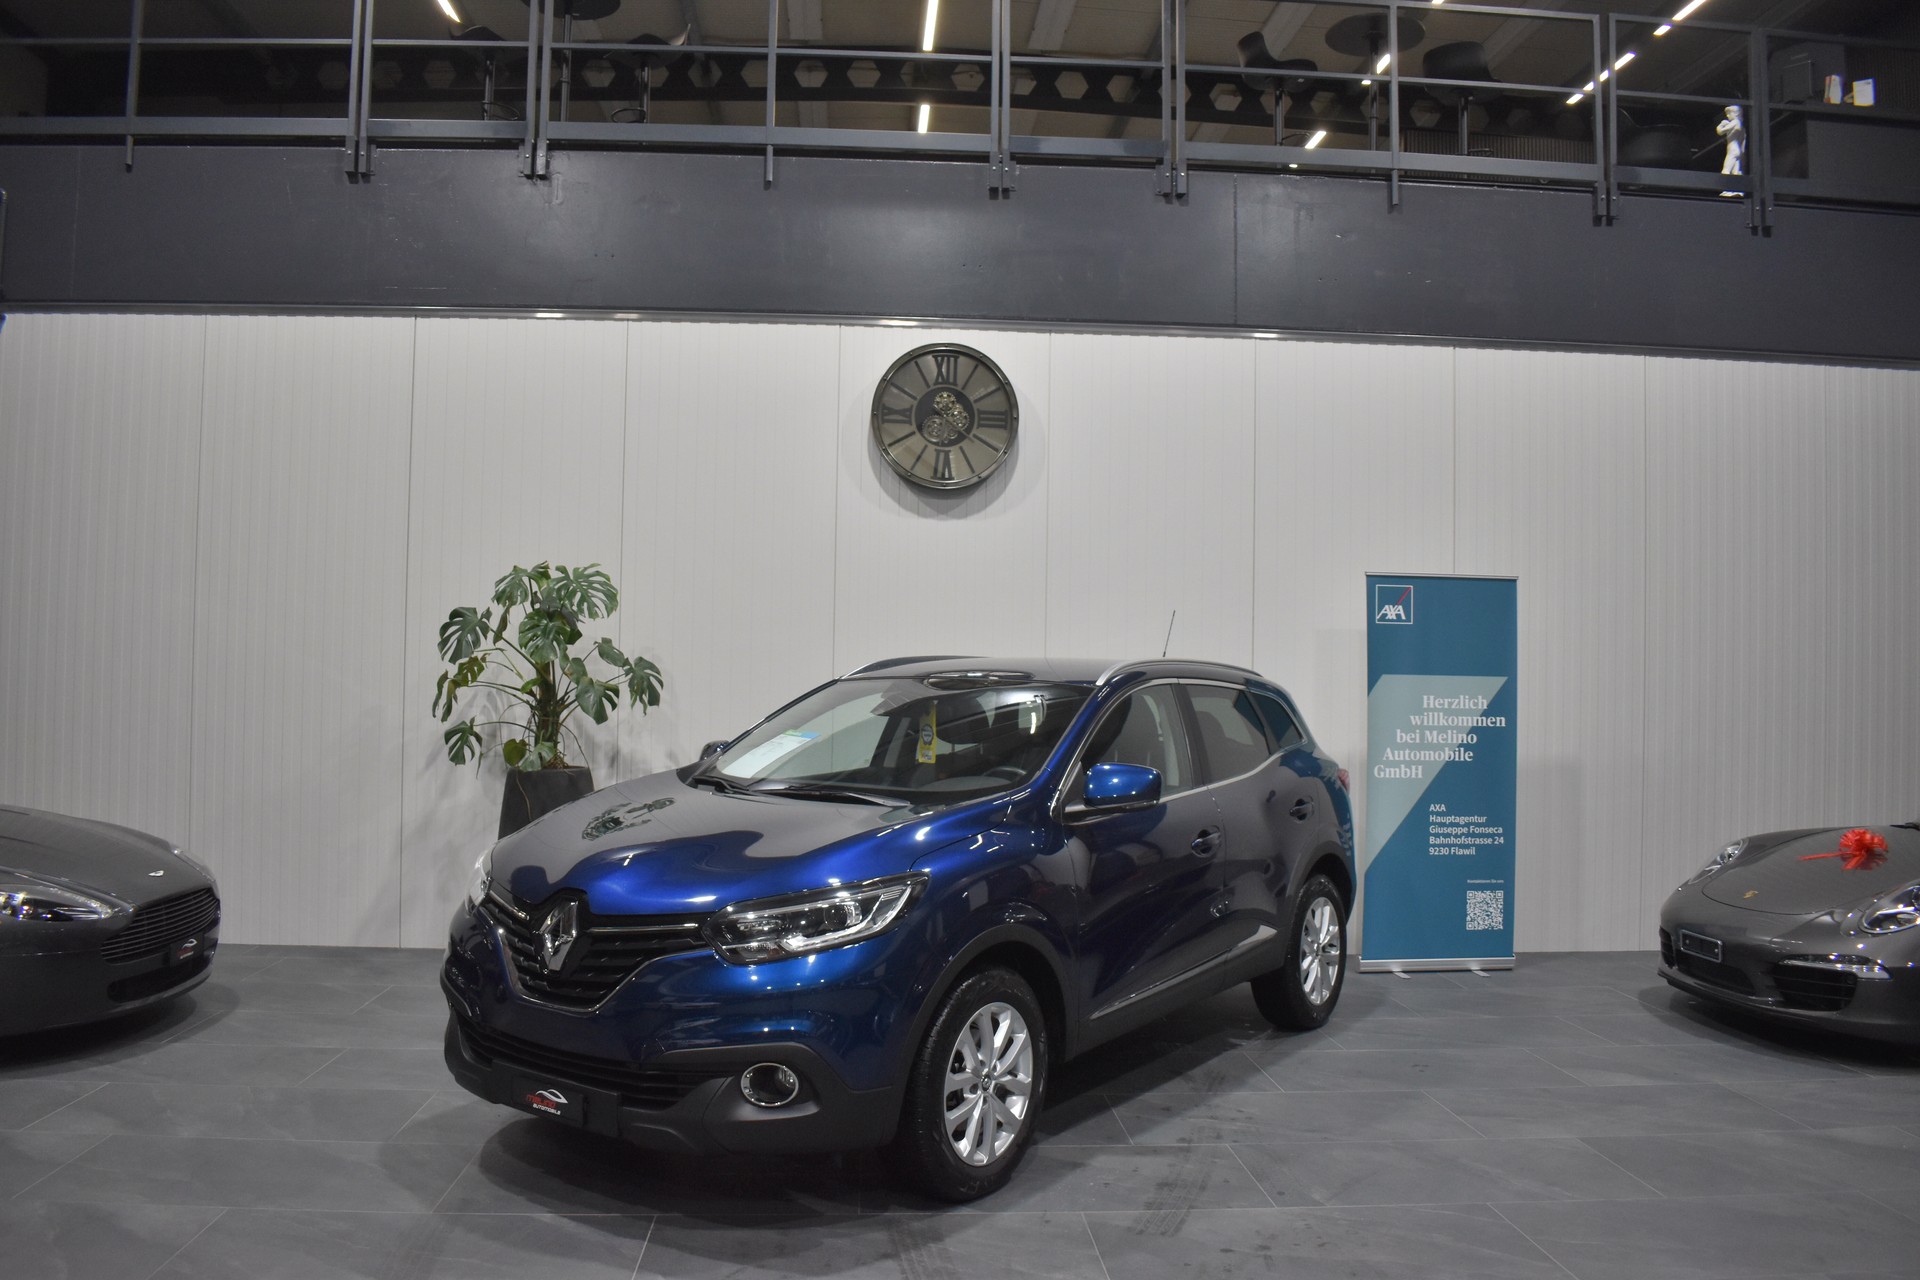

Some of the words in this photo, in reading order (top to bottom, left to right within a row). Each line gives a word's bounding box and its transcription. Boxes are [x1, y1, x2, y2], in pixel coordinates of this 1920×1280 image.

[932, 355, 960, 386] XII
[881, 403, 914, 425] IX
[976, 408, 1008, 430] III
[931, 449, 955, 480] VI
[1376, 605, 1406, 620] AXA
[1423, 695, 1488, 709] Herzlich
[1409, 712, 1506, 727] willkommen
[1396, 729, 1420, 743] bei
[1424, 729, 1477, 744] Melino
[1382, 747, 1474, 761] Automobile
[1373, 764, 1423, 779] GmbH
[1429, 804, 1446, 812] AXA
[1429, 814, 1487, 825] Hauptagentur
[1429, 825, 1468, 835] Giuseppe
[1469, 825, 1503, 834] Fonseca
[1429, 836, 1493, 845] Bahnhofstrasse
[1494, 836, 1504, 845] 24
[1429, 847, 1450, 855] 9230
[1450, 846, 1476, 855] Flawil
